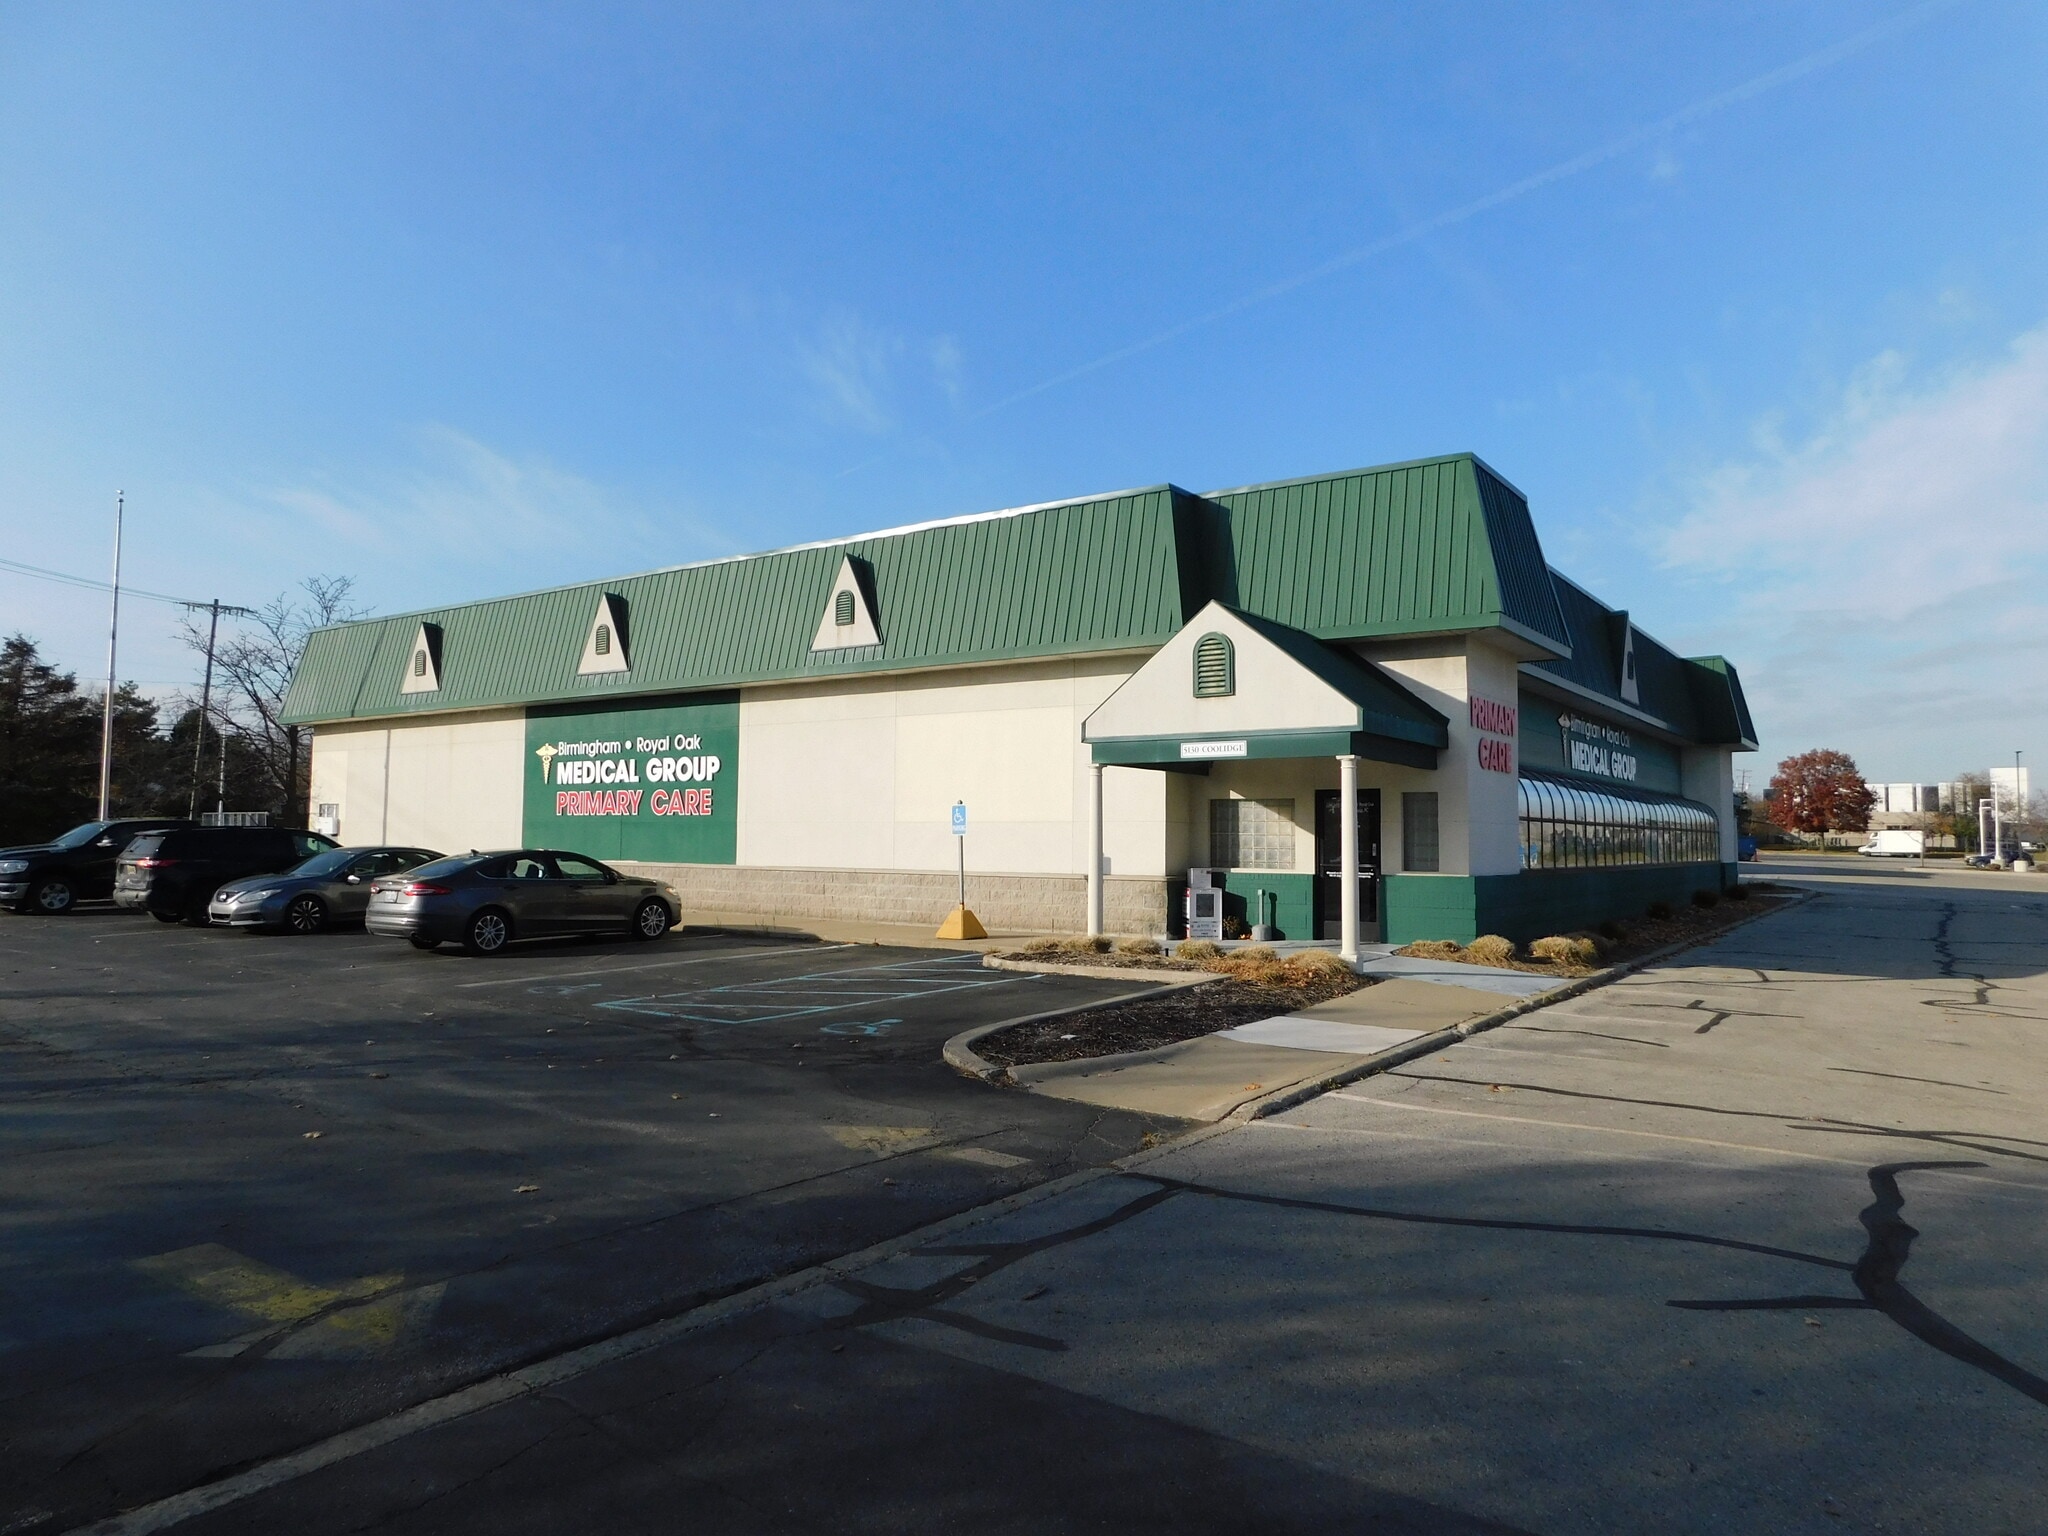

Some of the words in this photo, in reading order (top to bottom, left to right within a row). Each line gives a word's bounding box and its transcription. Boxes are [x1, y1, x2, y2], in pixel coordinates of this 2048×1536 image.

[1470, 695, 1516, 737] PRIMARY
[558, 739, 621, 757] Birmingham
[636, 735, 670, 755] Royal
[674, 734, 701, 750] Oak
[1202, 743, 1244, 753] COOLIDGE
[1478, 737, 1513, 774] CARE
[1570, 739, 1610, 776] MEDICAL
[1611, 751, 1637, 781] GROUP
[557, 759, 640, 785] MEDICAL
[646, 756, 720, 782] GROUP
[556, 789, 643, 816] PRIMARY
[651, 788, 712, 816] CARE
